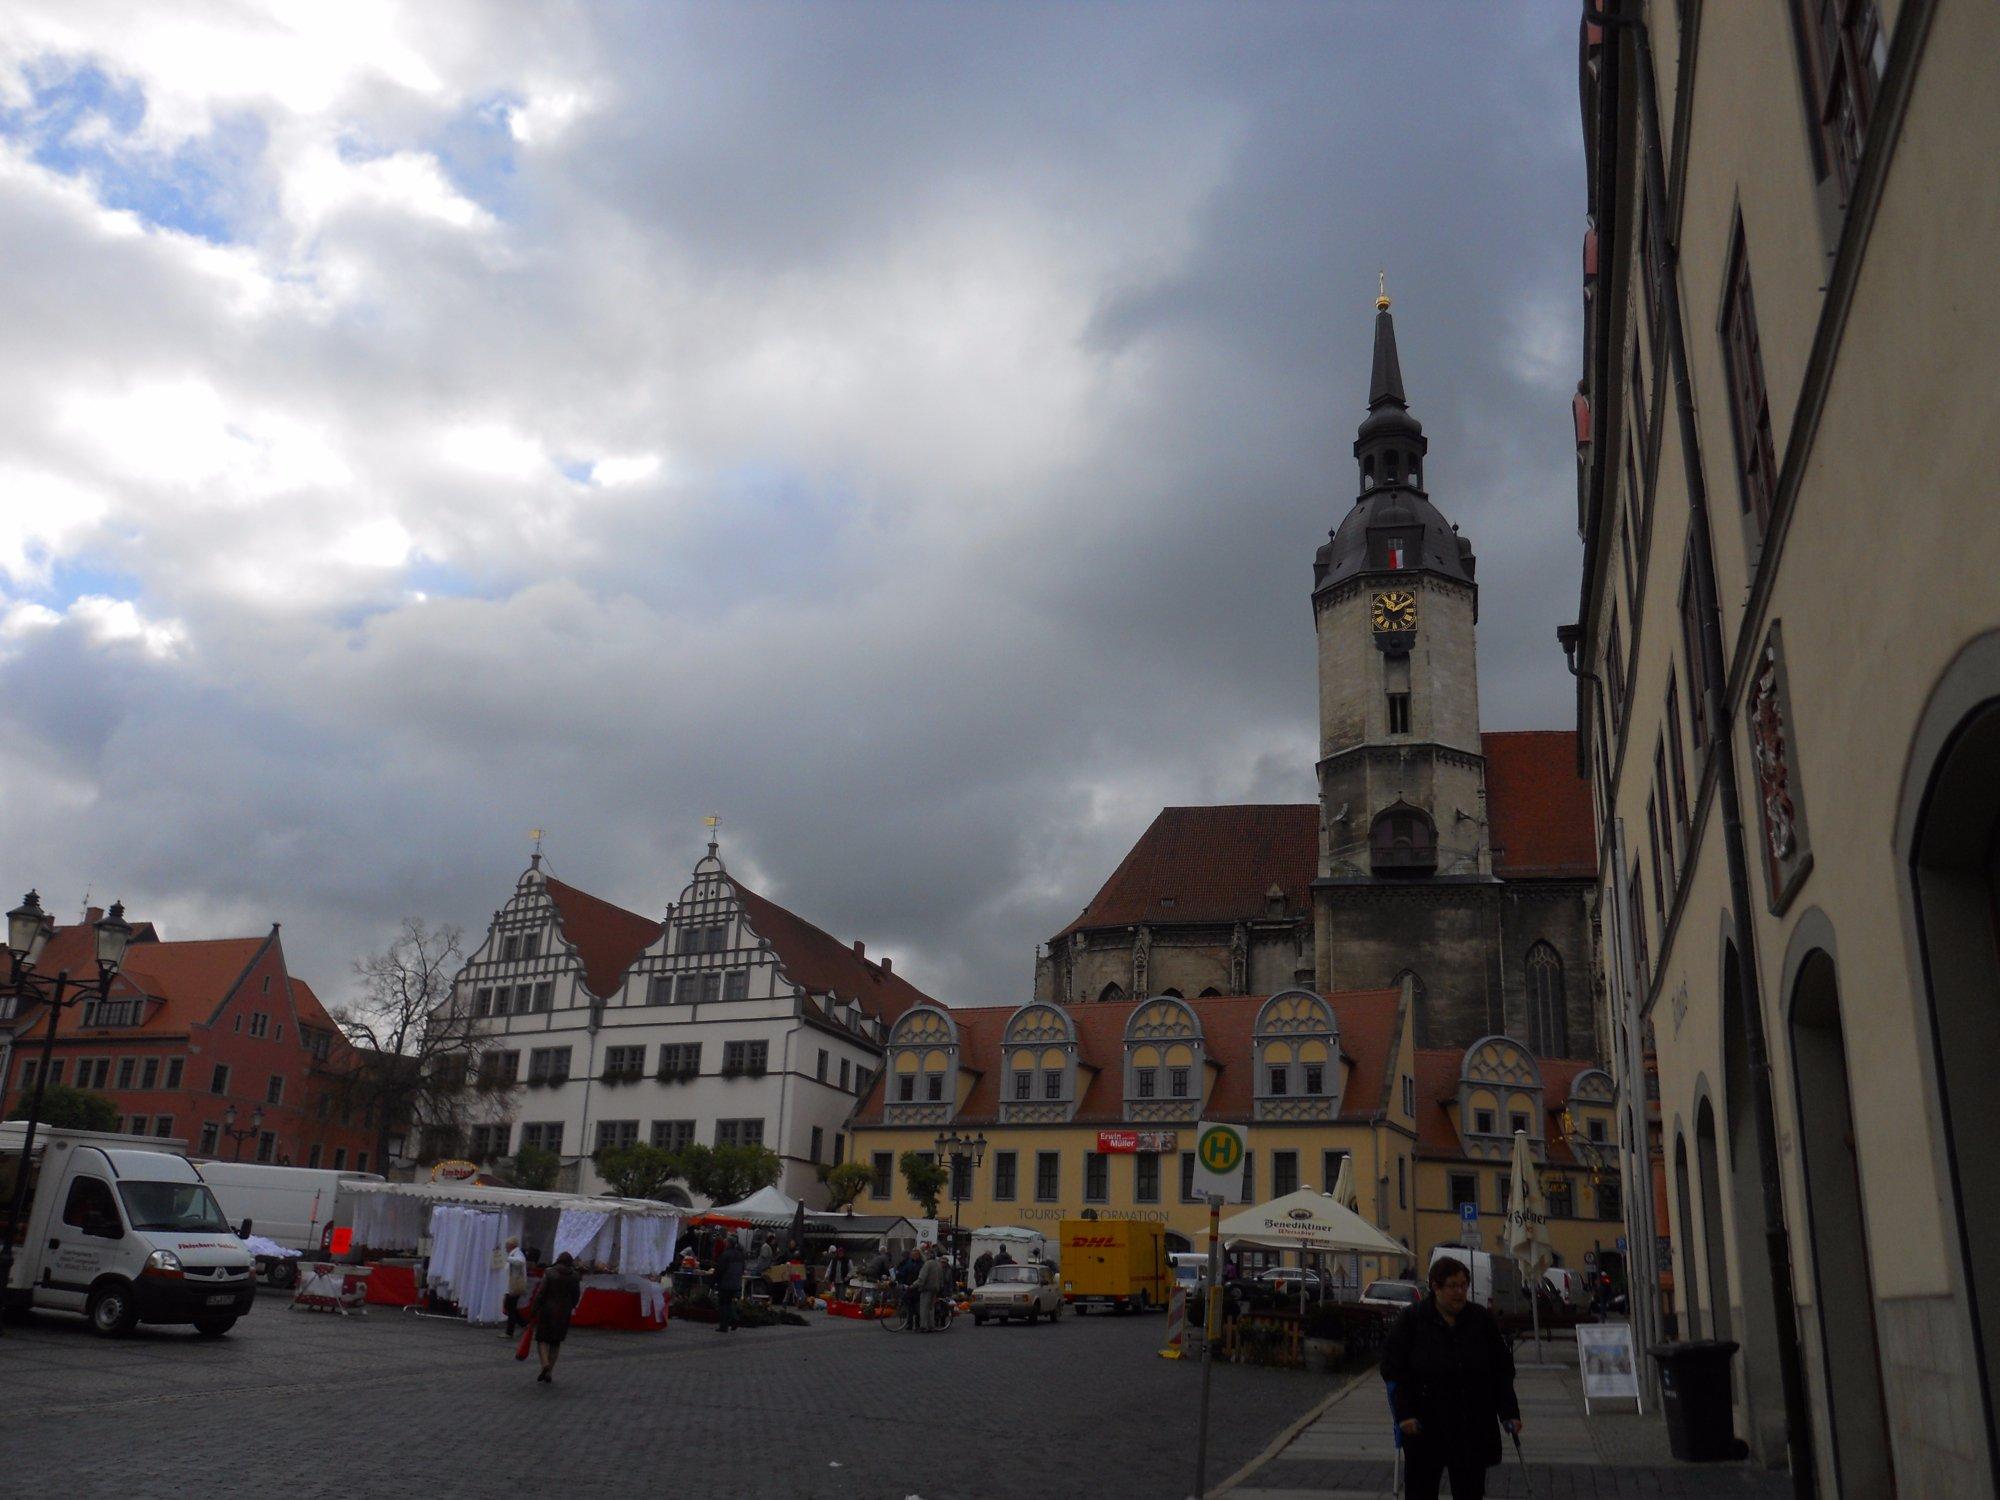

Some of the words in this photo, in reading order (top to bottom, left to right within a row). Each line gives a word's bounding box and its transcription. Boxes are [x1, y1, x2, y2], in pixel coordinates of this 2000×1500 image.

[1100, 1132, 1121, 1140] Erwin
[1110, 1139, 1134, 1147] Müller
[1210, 1135, 1231, 1163] H
[1018, 1208, 1066, 1220] TOURIST
[1081, 1208, 1169, 1222] FORMATION
[1464, 1205, 1473, 1219] P
[1264, 1218, 1332, 1232] Benediktiner
[1072, 1237, 1116, 1247] DHL
